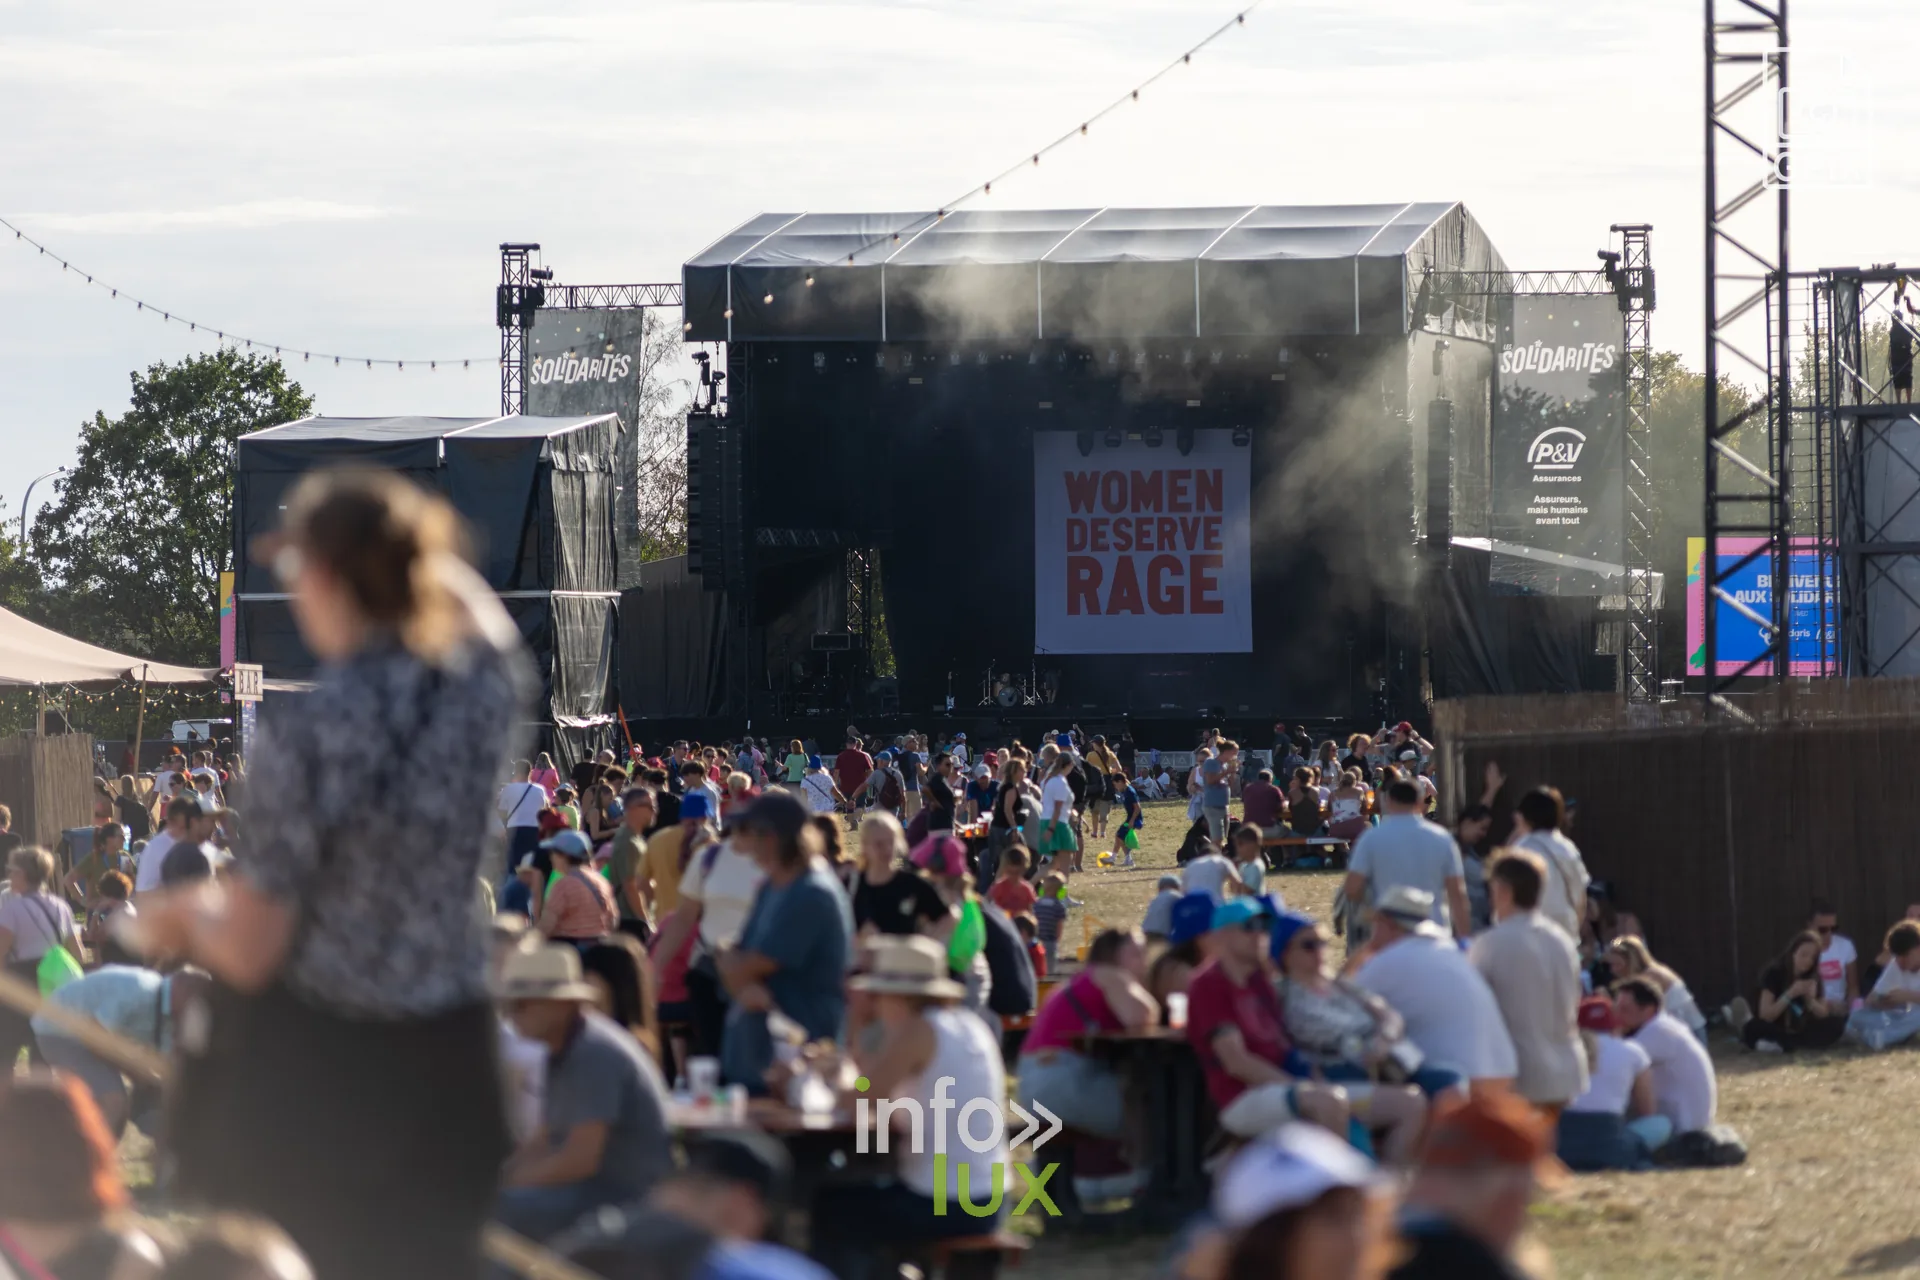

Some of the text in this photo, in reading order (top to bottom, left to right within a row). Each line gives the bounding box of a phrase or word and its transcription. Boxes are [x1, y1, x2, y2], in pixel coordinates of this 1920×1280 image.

[1535, 443, 1584, 463] P&V
[1532, 474, 1582, 482] Assurances
[1063, 468, 1224, 515] WOMEN
[1533, 495, 1582, 504] Assureurs,
[1527, 506, 1588, 514] mais humains
[1066, 516, 1224, 553] DESERVE
[1066, 554, 1224, 616] RAGE
[1735, 590, 1767, 603] AUX
[240, 670, 258, 694] BAR
